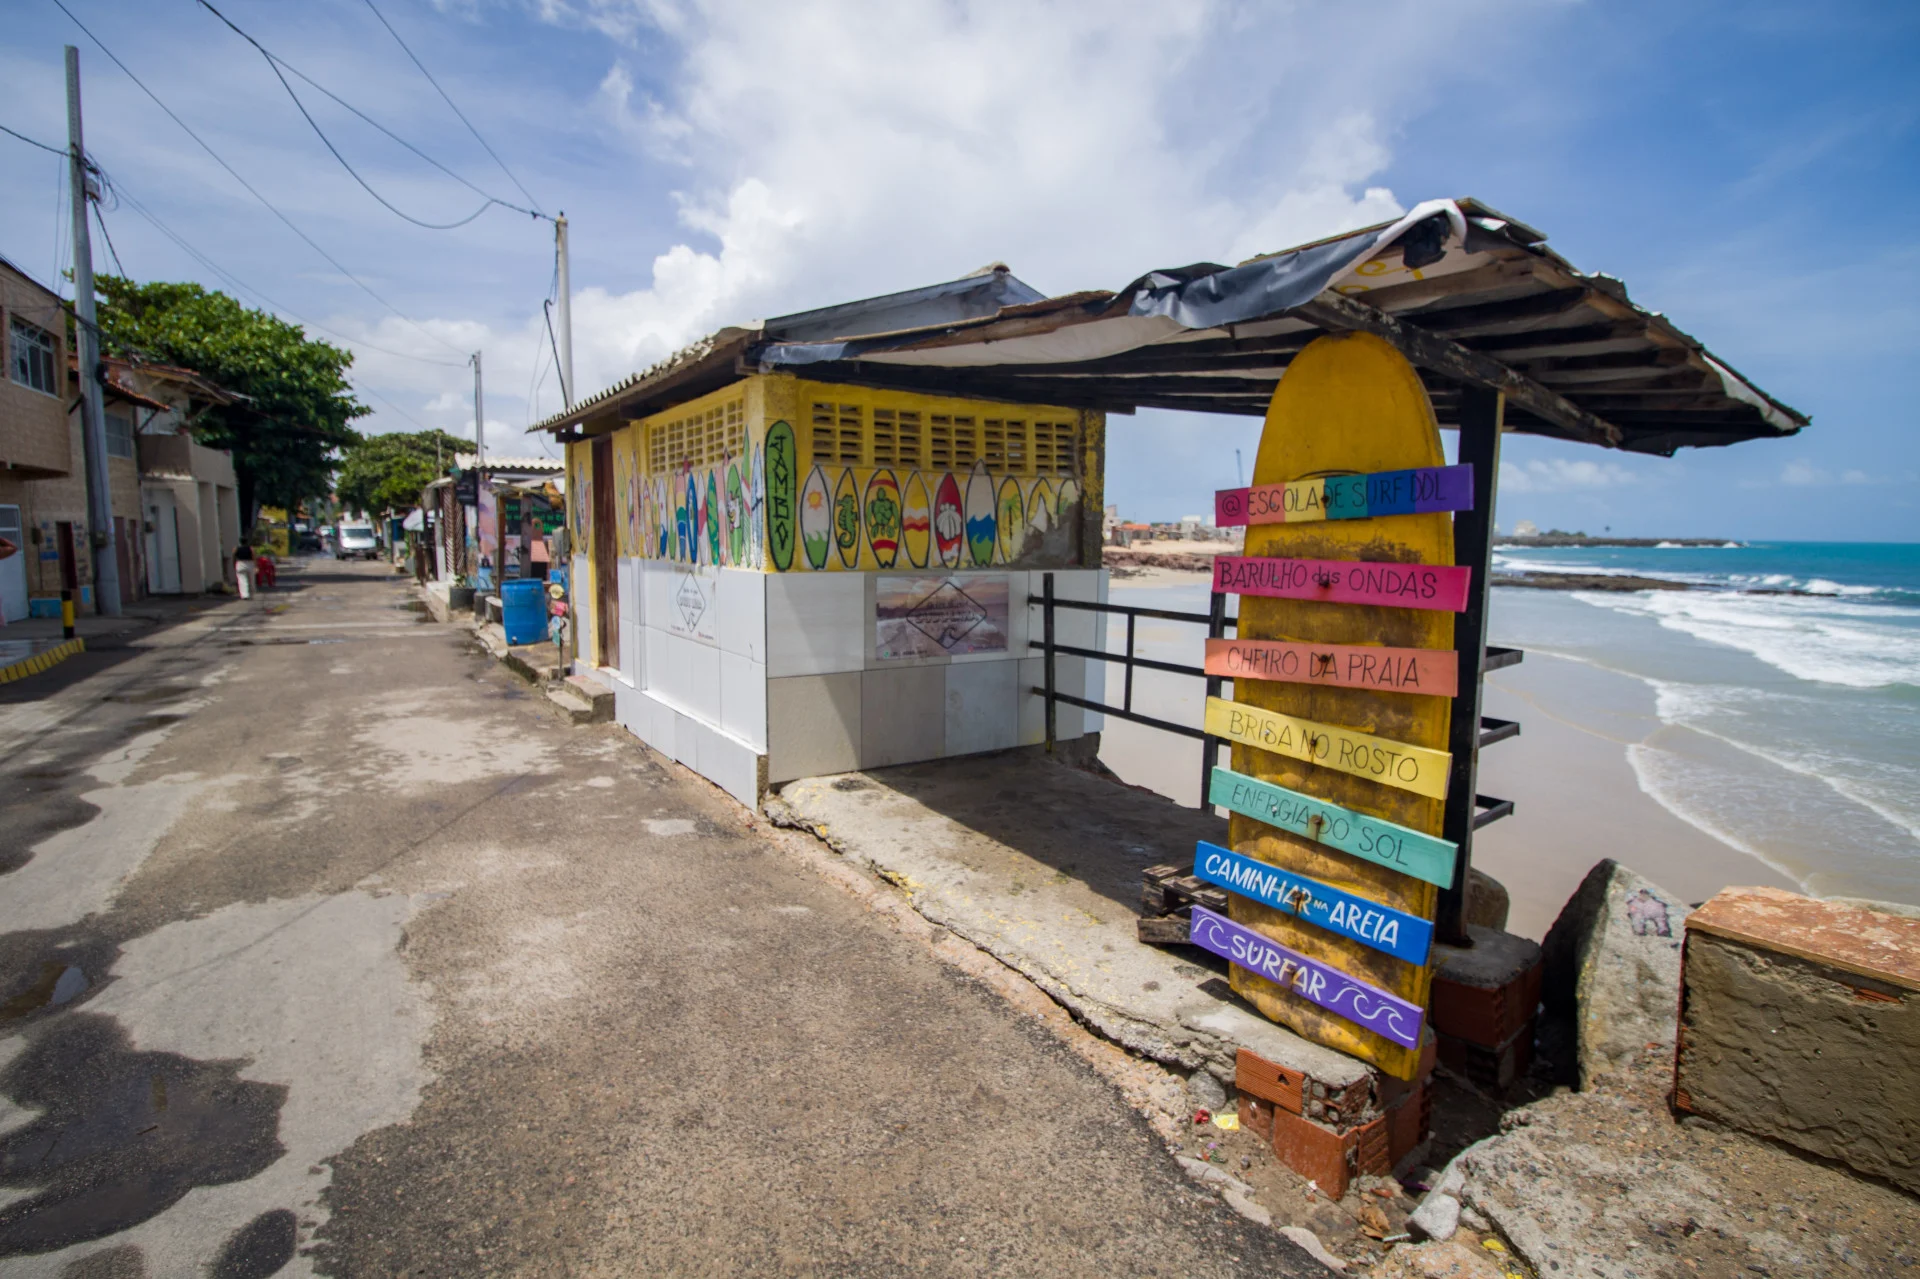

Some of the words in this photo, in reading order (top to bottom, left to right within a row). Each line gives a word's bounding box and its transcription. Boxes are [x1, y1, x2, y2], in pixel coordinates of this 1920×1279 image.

[1352, 476, 1403, 508] SURF
[1410, 472, 1446, 503] DDL
[1218, 561, 1308, 589] BARULHO
[1348, 568, 1438, 599] ONDAS
[1310, 652, 1338, 680] DA
[1347, 654, 1420, 687] PRAIA
[1229, 710, 1293, 750] BRISA
[1300, 729, 1330, 760] NO
[1338, 738, 1419, 782] ROSTO
[1318, 811, 1350, 841] DO
[1358, 827, 1409, 866] SOL
[1205, 853, 1312, 917] CAMINHAR
[1313, 899, 1329, 913] NA
[1328, 900, 1400, 949] AREIA
[1230, 934, 1327, 1001] SURFAR
